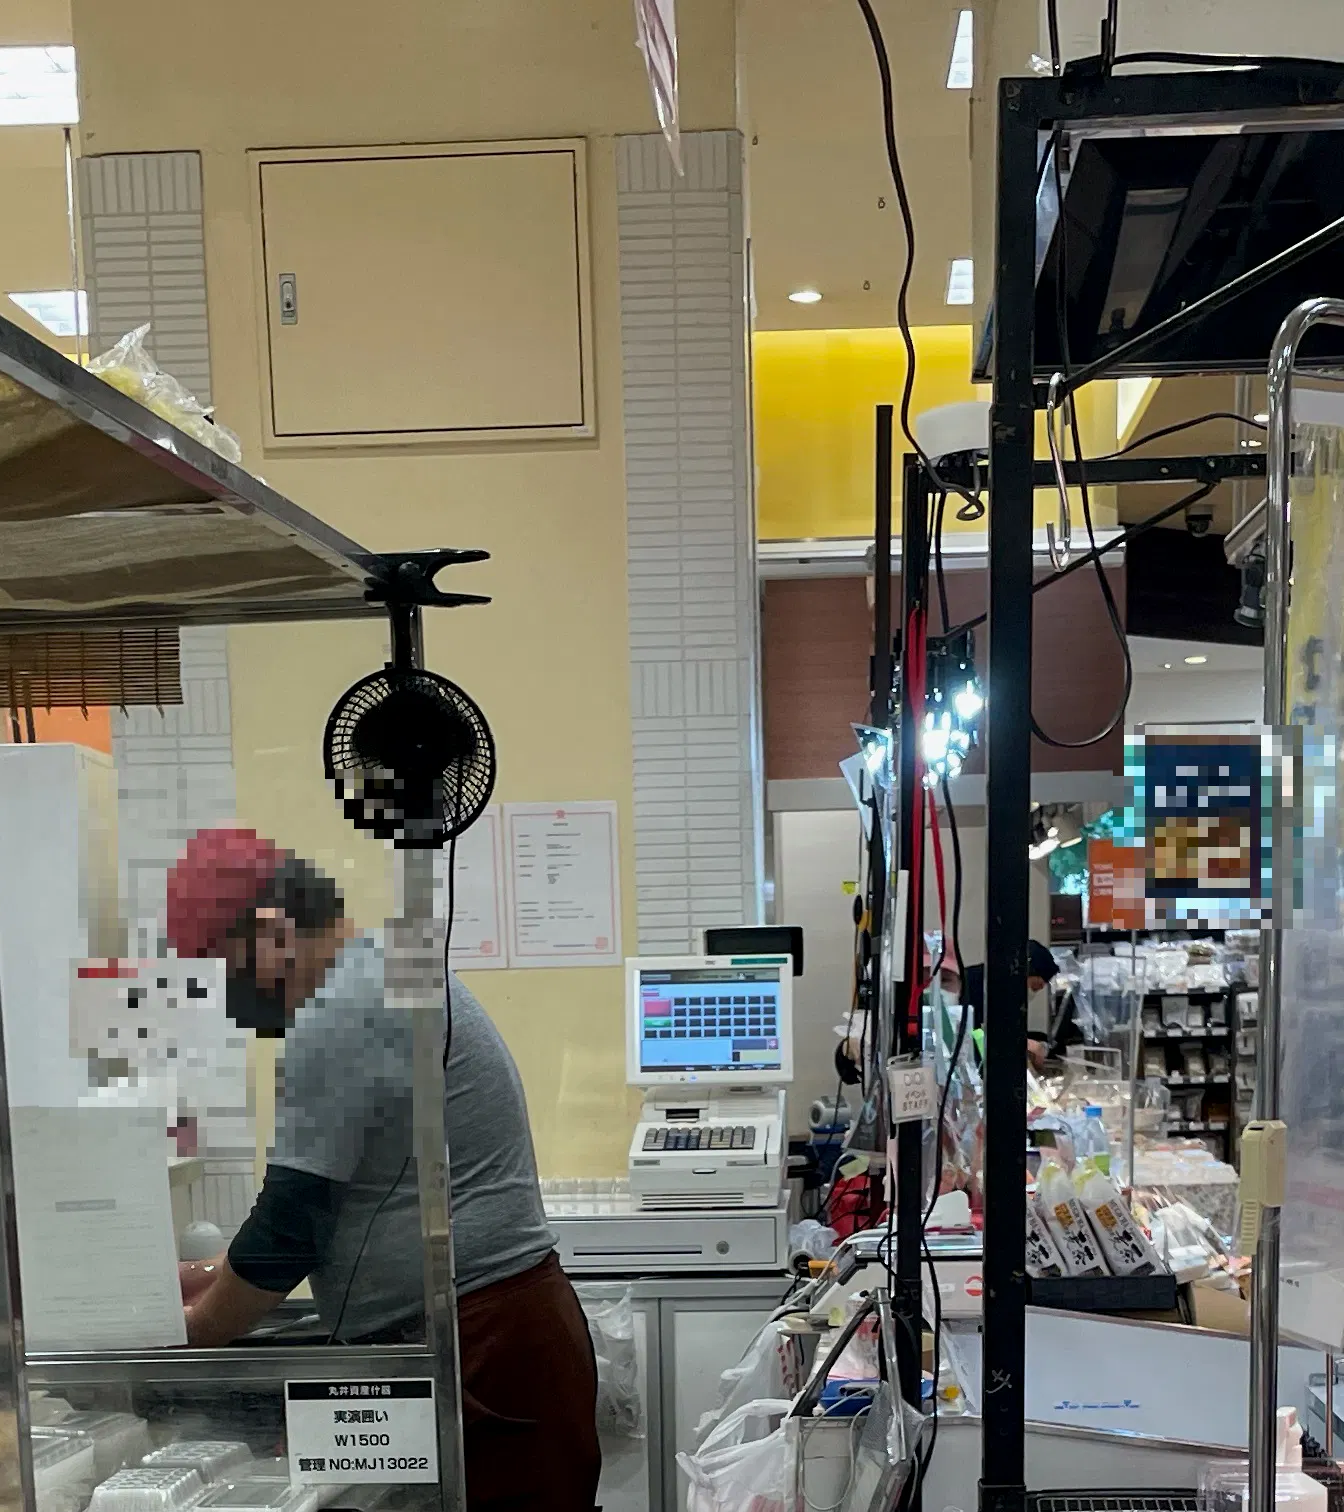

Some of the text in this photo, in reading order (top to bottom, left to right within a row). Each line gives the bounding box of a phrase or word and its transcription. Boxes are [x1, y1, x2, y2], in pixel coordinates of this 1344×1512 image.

[328, 1384, 392, 1396] 丸井資産什器
[333, 1409, 389, 1424] 実演囲い
[334, 1433, 390, 1447] W1500
[298, 1456, 429, 1472] 管理 NO:MJ13022
